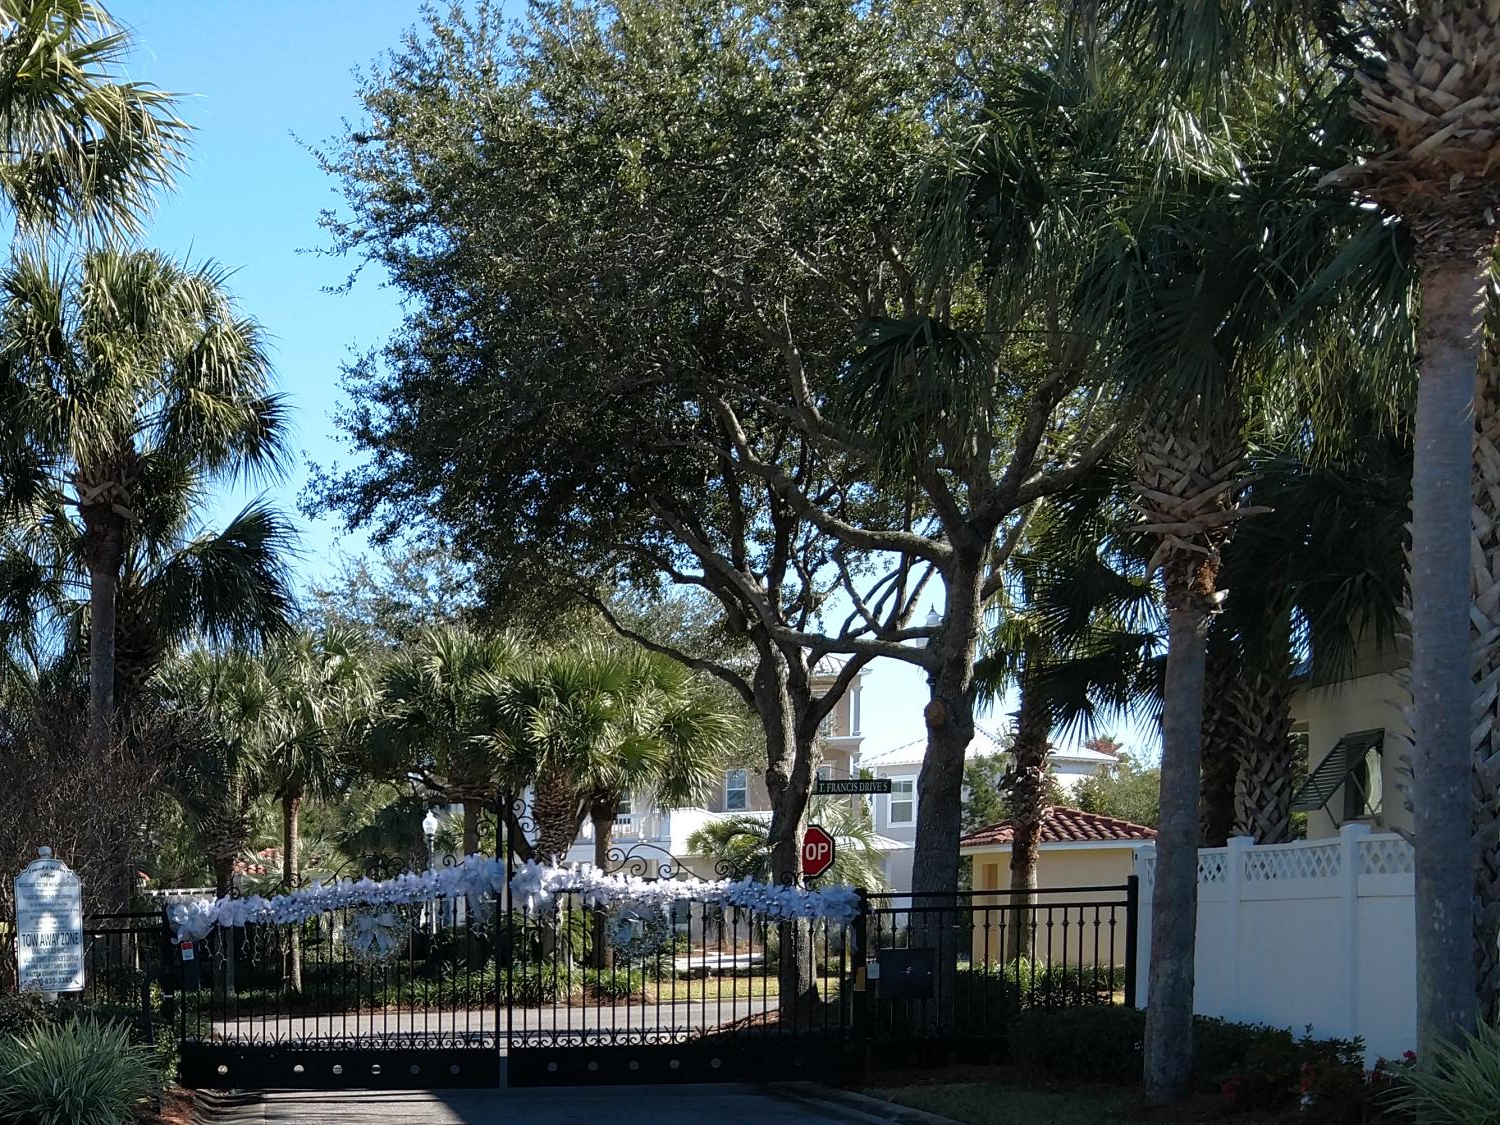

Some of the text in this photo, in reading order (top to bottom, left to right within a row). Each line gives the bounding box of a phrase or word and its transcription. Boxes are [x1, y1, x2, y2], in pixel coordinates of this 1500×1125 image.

[826, 782, 858, 793] FRANCIS
[859, 781, 882, 792] DRIVE
[803, 842, 829, 861] OP
[21, 931, 79, 947] TOW AWAY ZONE
